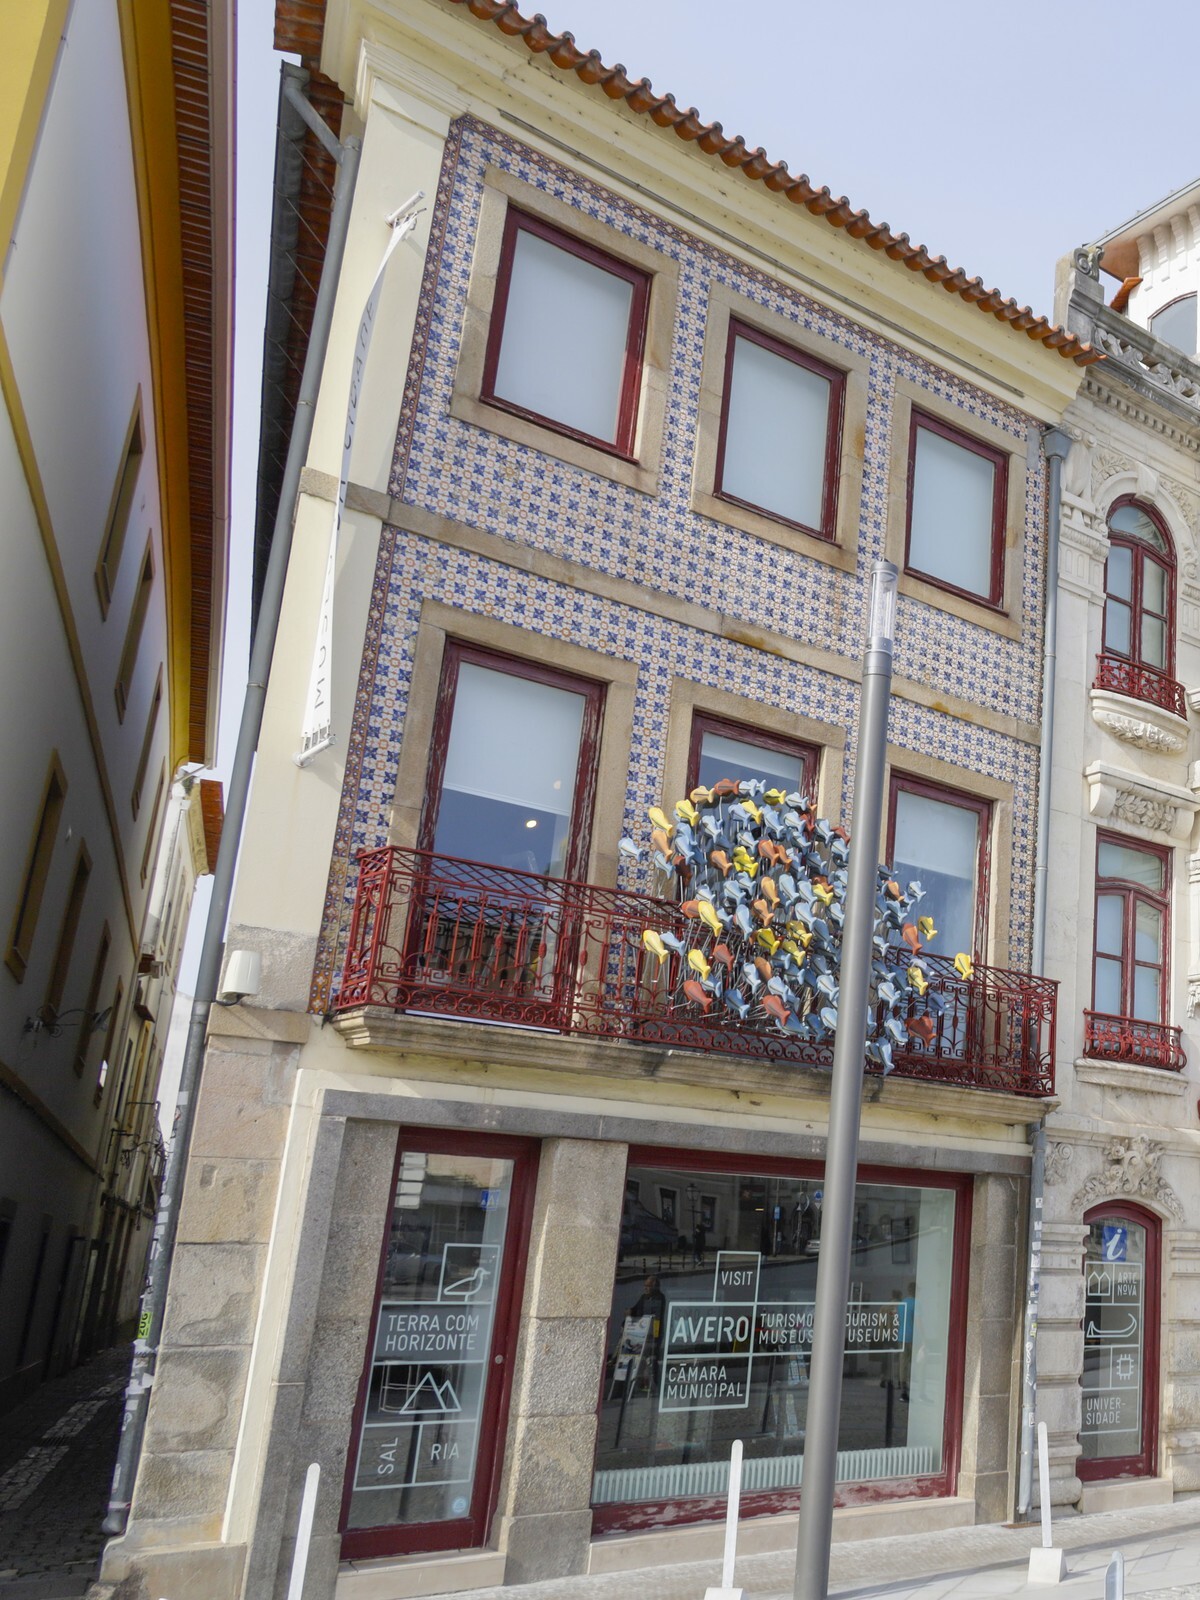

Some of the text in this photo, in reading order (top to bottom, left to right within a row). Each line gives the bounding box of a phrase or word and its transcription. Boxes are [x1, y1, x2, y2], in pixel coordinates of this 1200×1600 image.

[721, 1270, 754, 1286] VISIT
[1117, 1271, 1137, 1284] ARTE
[388, 1314, 480, 1332] TERRA COM
[760, 1313, 814, 1328] TURISMO
[845, 1313, 900, 1327] OURISM &
[385, 1333, 478, 1351] HORIZONTE
[758, 1329, 814, 1345] MUSEUS
[848, 1328, 899, 1342] USEUMS
[666, 1382, 744, 1400] MUNICIPAL
[1086, 1397, 1127, 1411] UNIVER-
[1085, 1411, 1121, 1425] SIDADE
[377, 1437, 399, 1475] SAL
[430, 1443, 460, 1461] RIA
